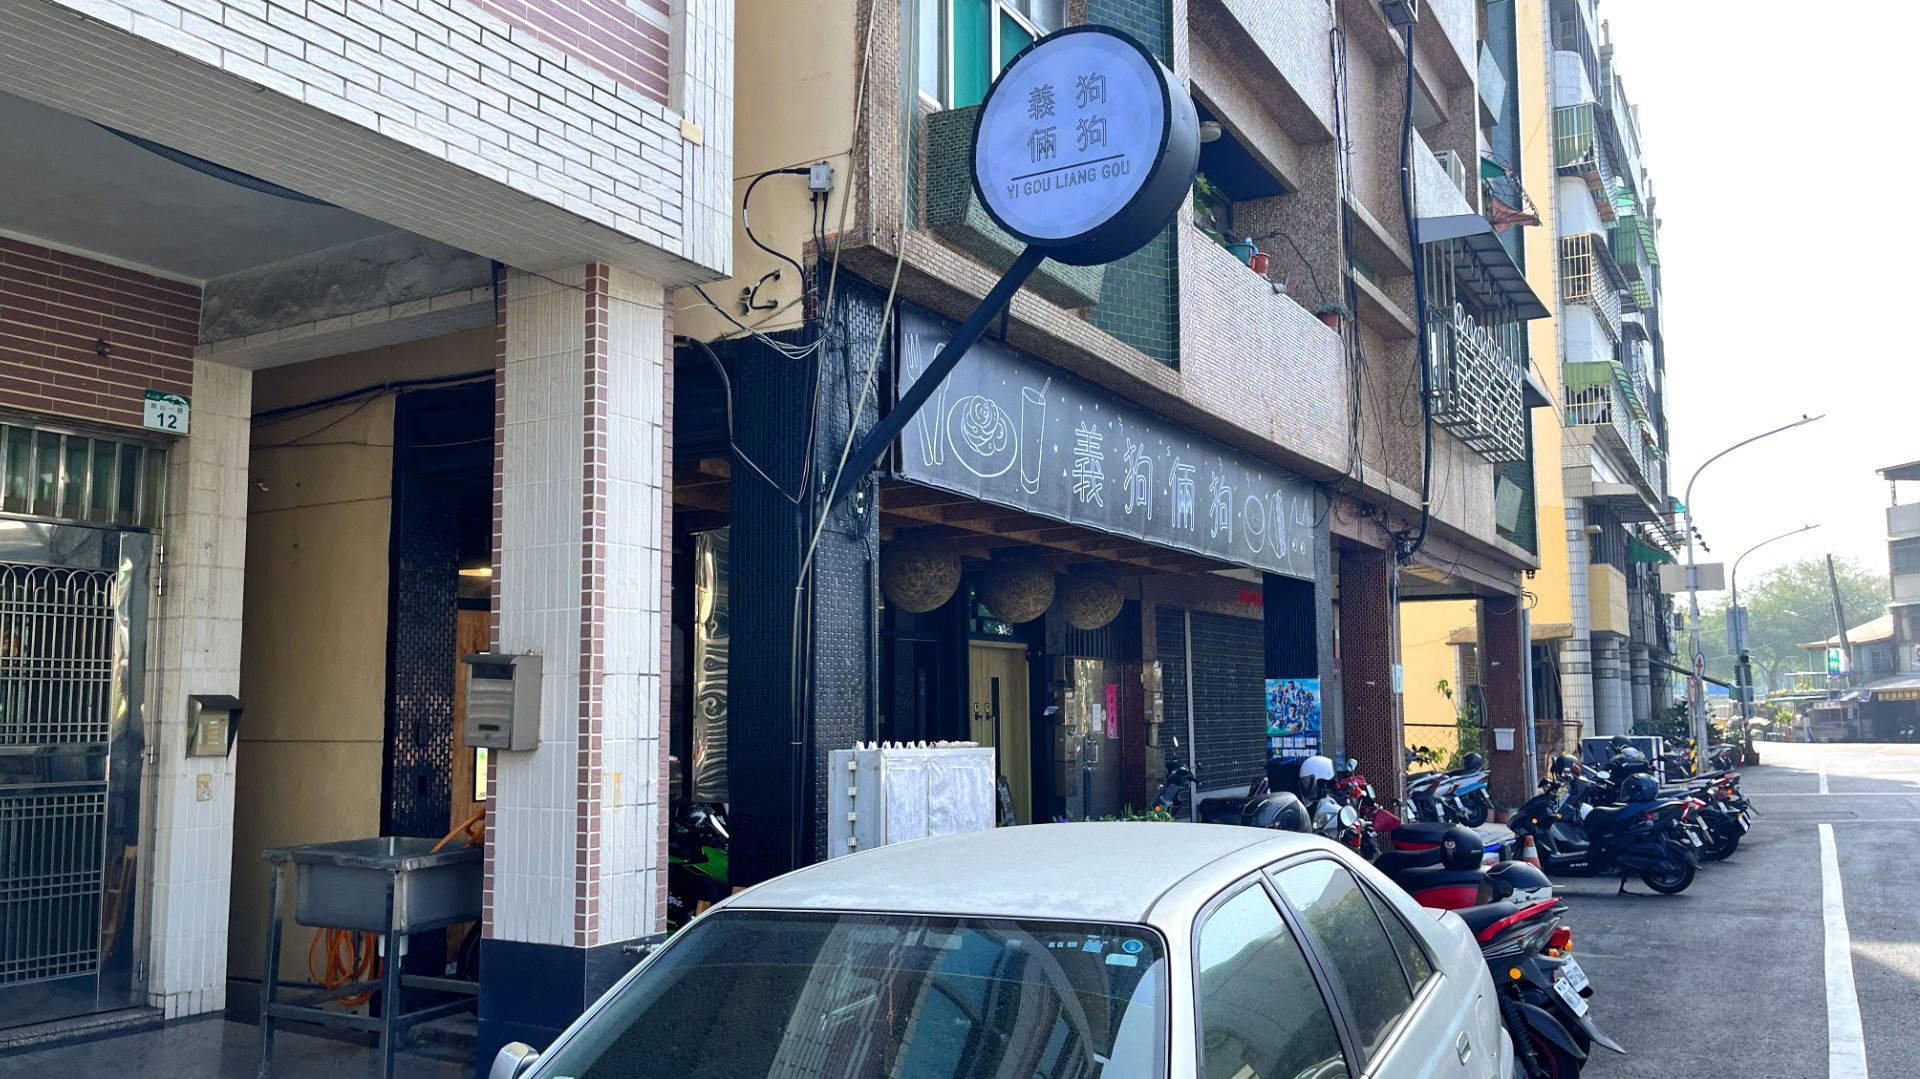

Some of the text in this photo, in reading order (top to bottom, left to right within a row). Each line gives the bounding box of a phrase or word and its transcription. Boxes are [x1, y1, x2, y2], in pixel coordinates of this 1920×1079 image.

[1007, 160, 1131, 200] YI GOU LIANG GOU
[157, 412, 177, 429] 12
[1072, 420, 1234, 544] 義狗倆狗
